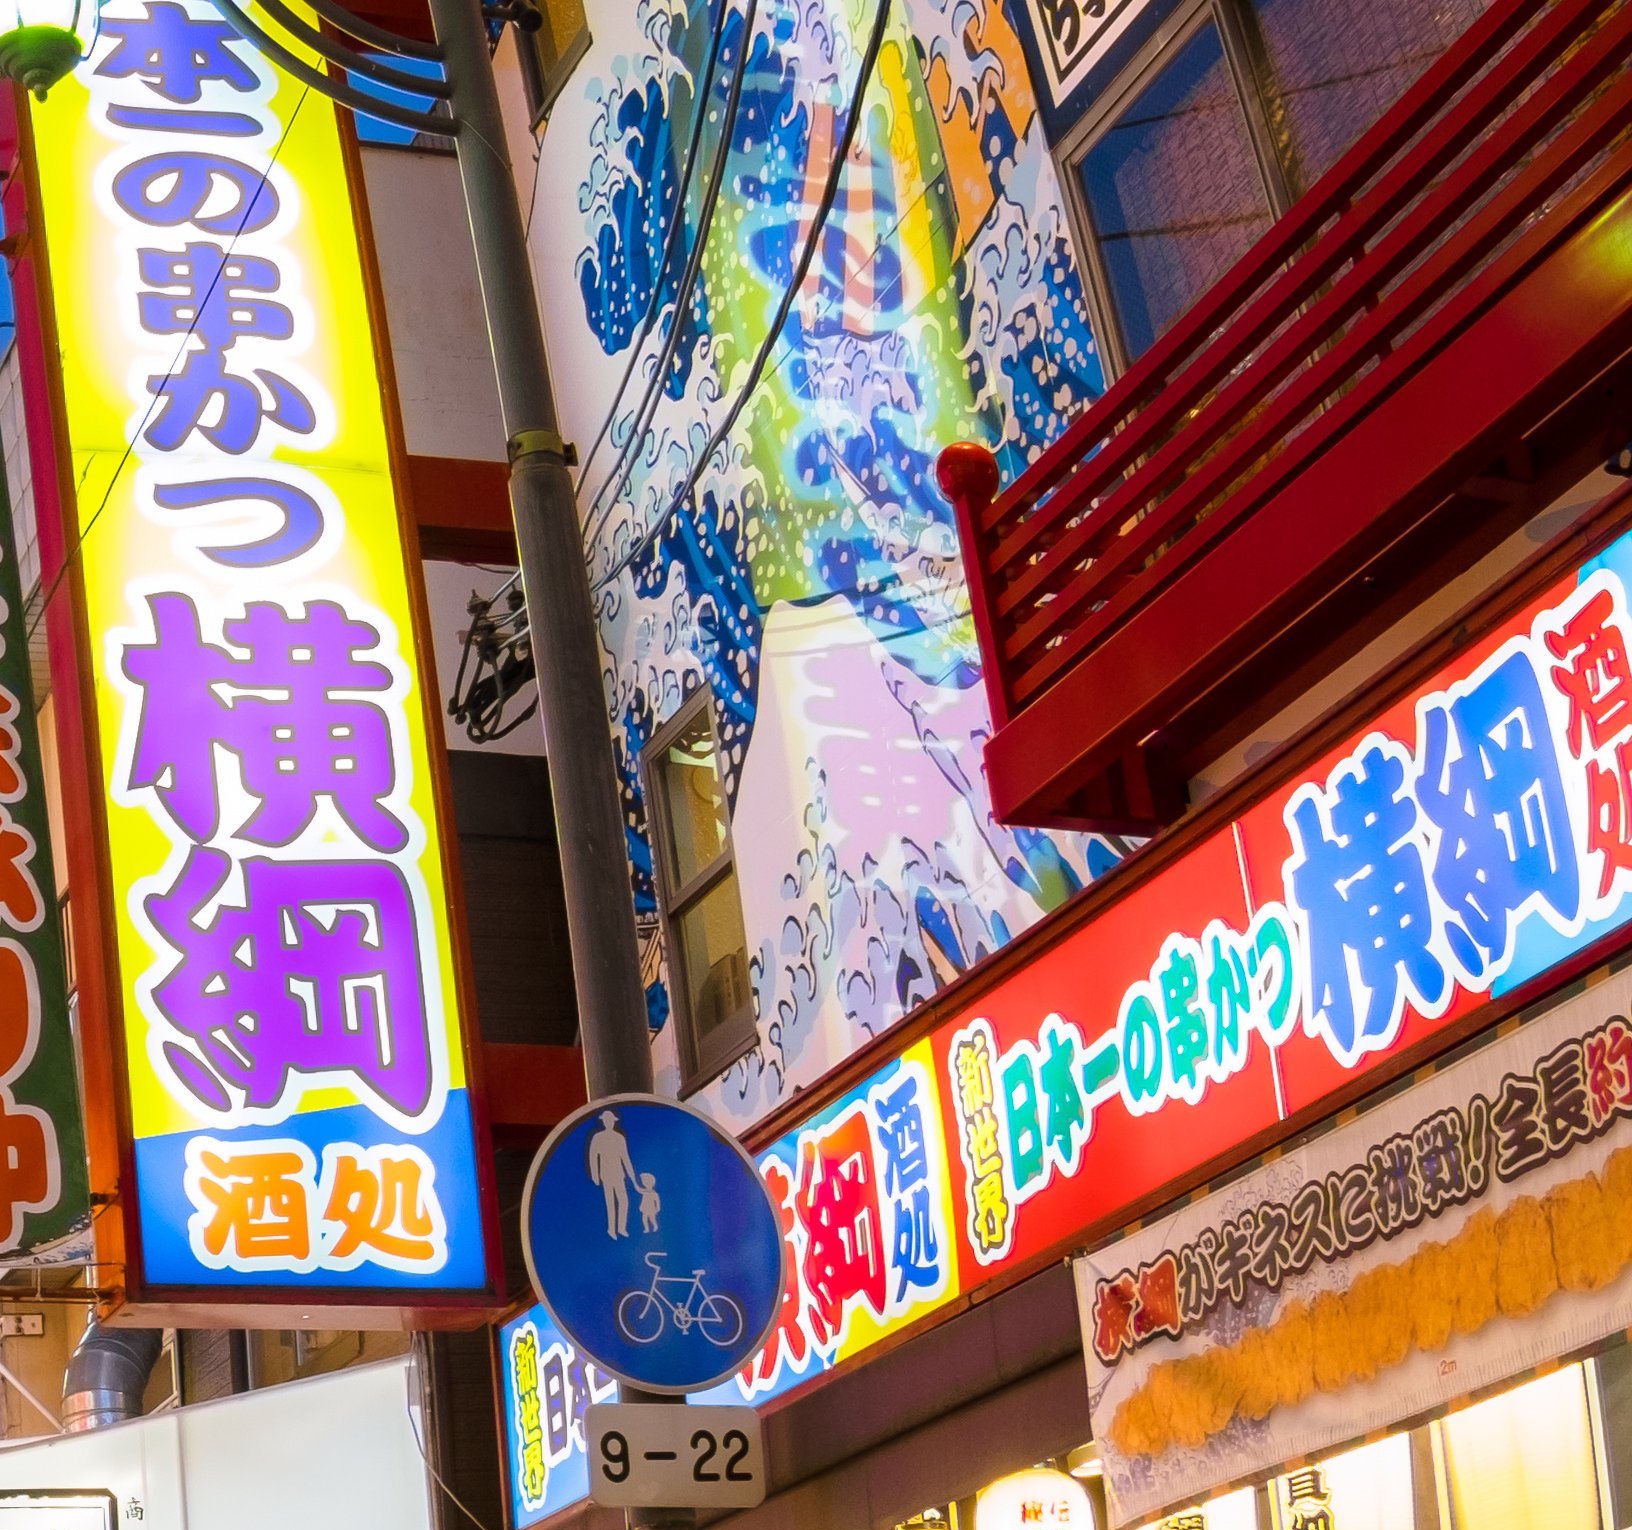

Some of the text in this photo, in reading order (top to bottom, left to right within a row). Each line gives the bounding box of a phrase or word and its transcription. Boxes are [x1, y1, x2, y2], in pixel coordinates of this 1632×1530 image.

[126, 590, 433, 1122] 横綱
[1288, 650, 1578, 1055] 横綱
[956, 1025, 1006, 1258] 新世界
[1002, 910, 1292, 1190] 日本一の串かつ
[200, 1152, 438, 1262] 酒処
[874, 1078, 942, 1304] 酒処
[515, 1330, 545, 1500] 新世界
